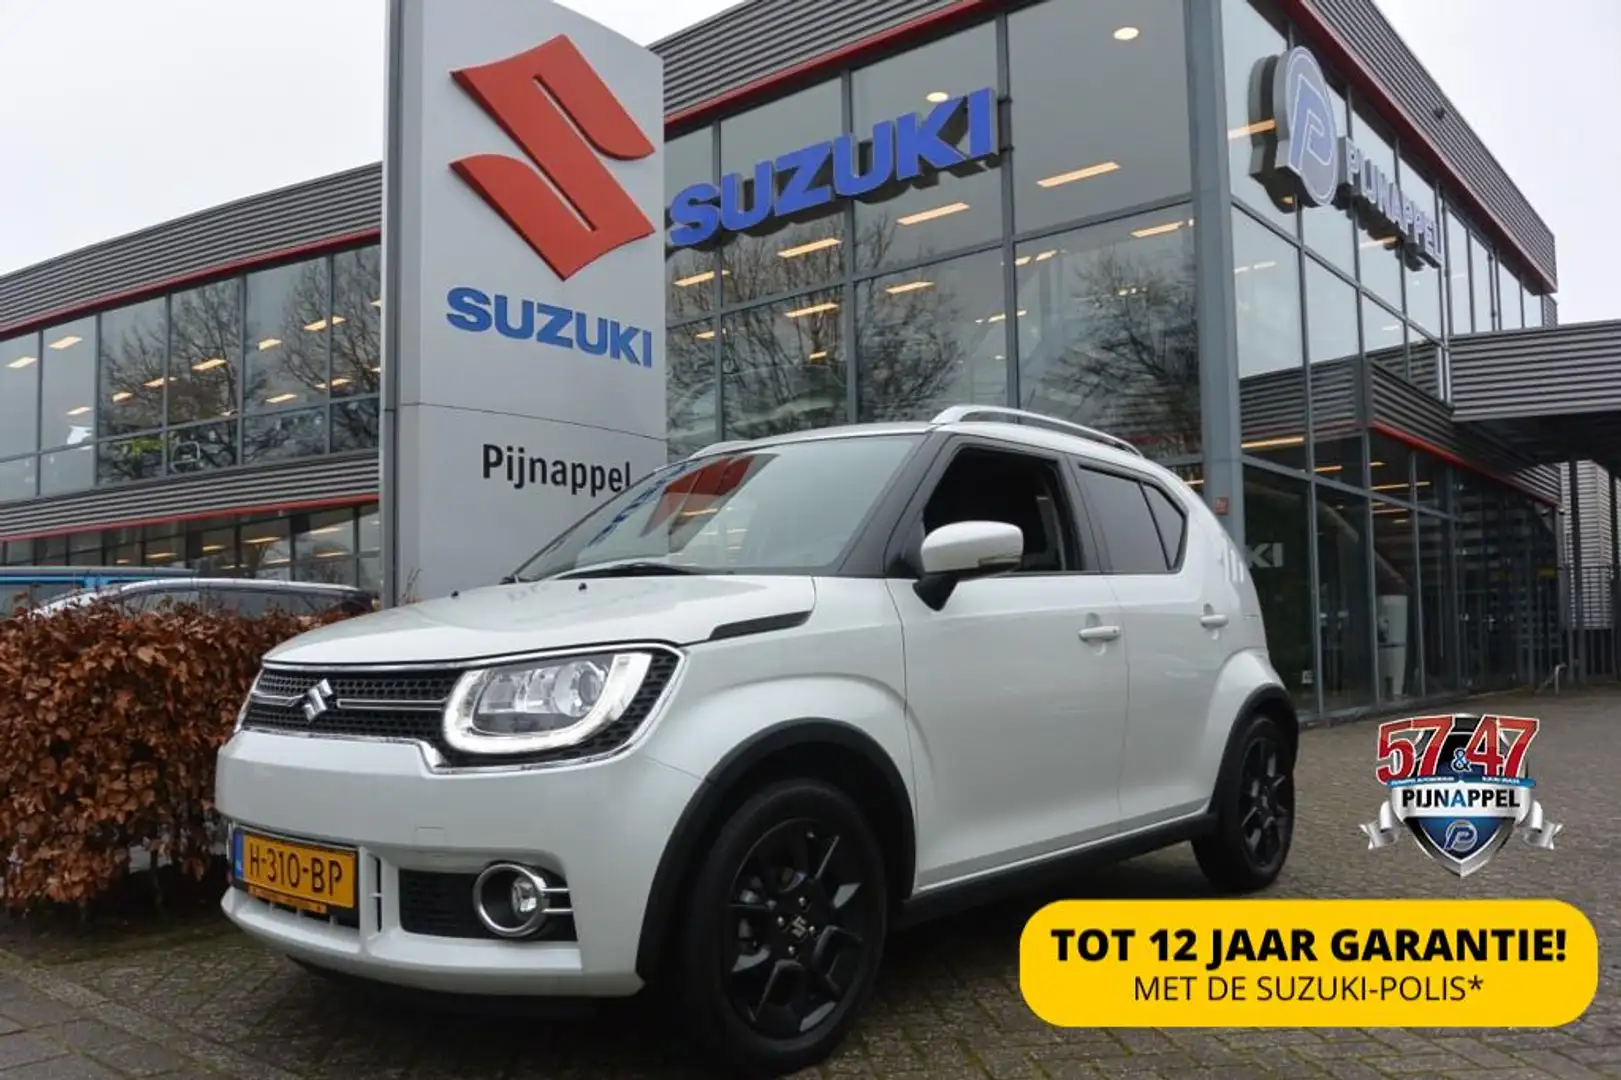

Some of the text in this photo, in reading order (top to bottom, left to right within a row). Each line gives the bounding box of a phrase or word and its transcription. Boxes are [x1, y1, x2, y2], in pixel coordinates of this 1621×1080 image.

[669, 87, 996, 247] SUZUKI
[446, 286, 653, 369] SUZUKI
[482, 443, 631, 497] Pijnappel
[249, 843, 343, 896] H-310-BP
